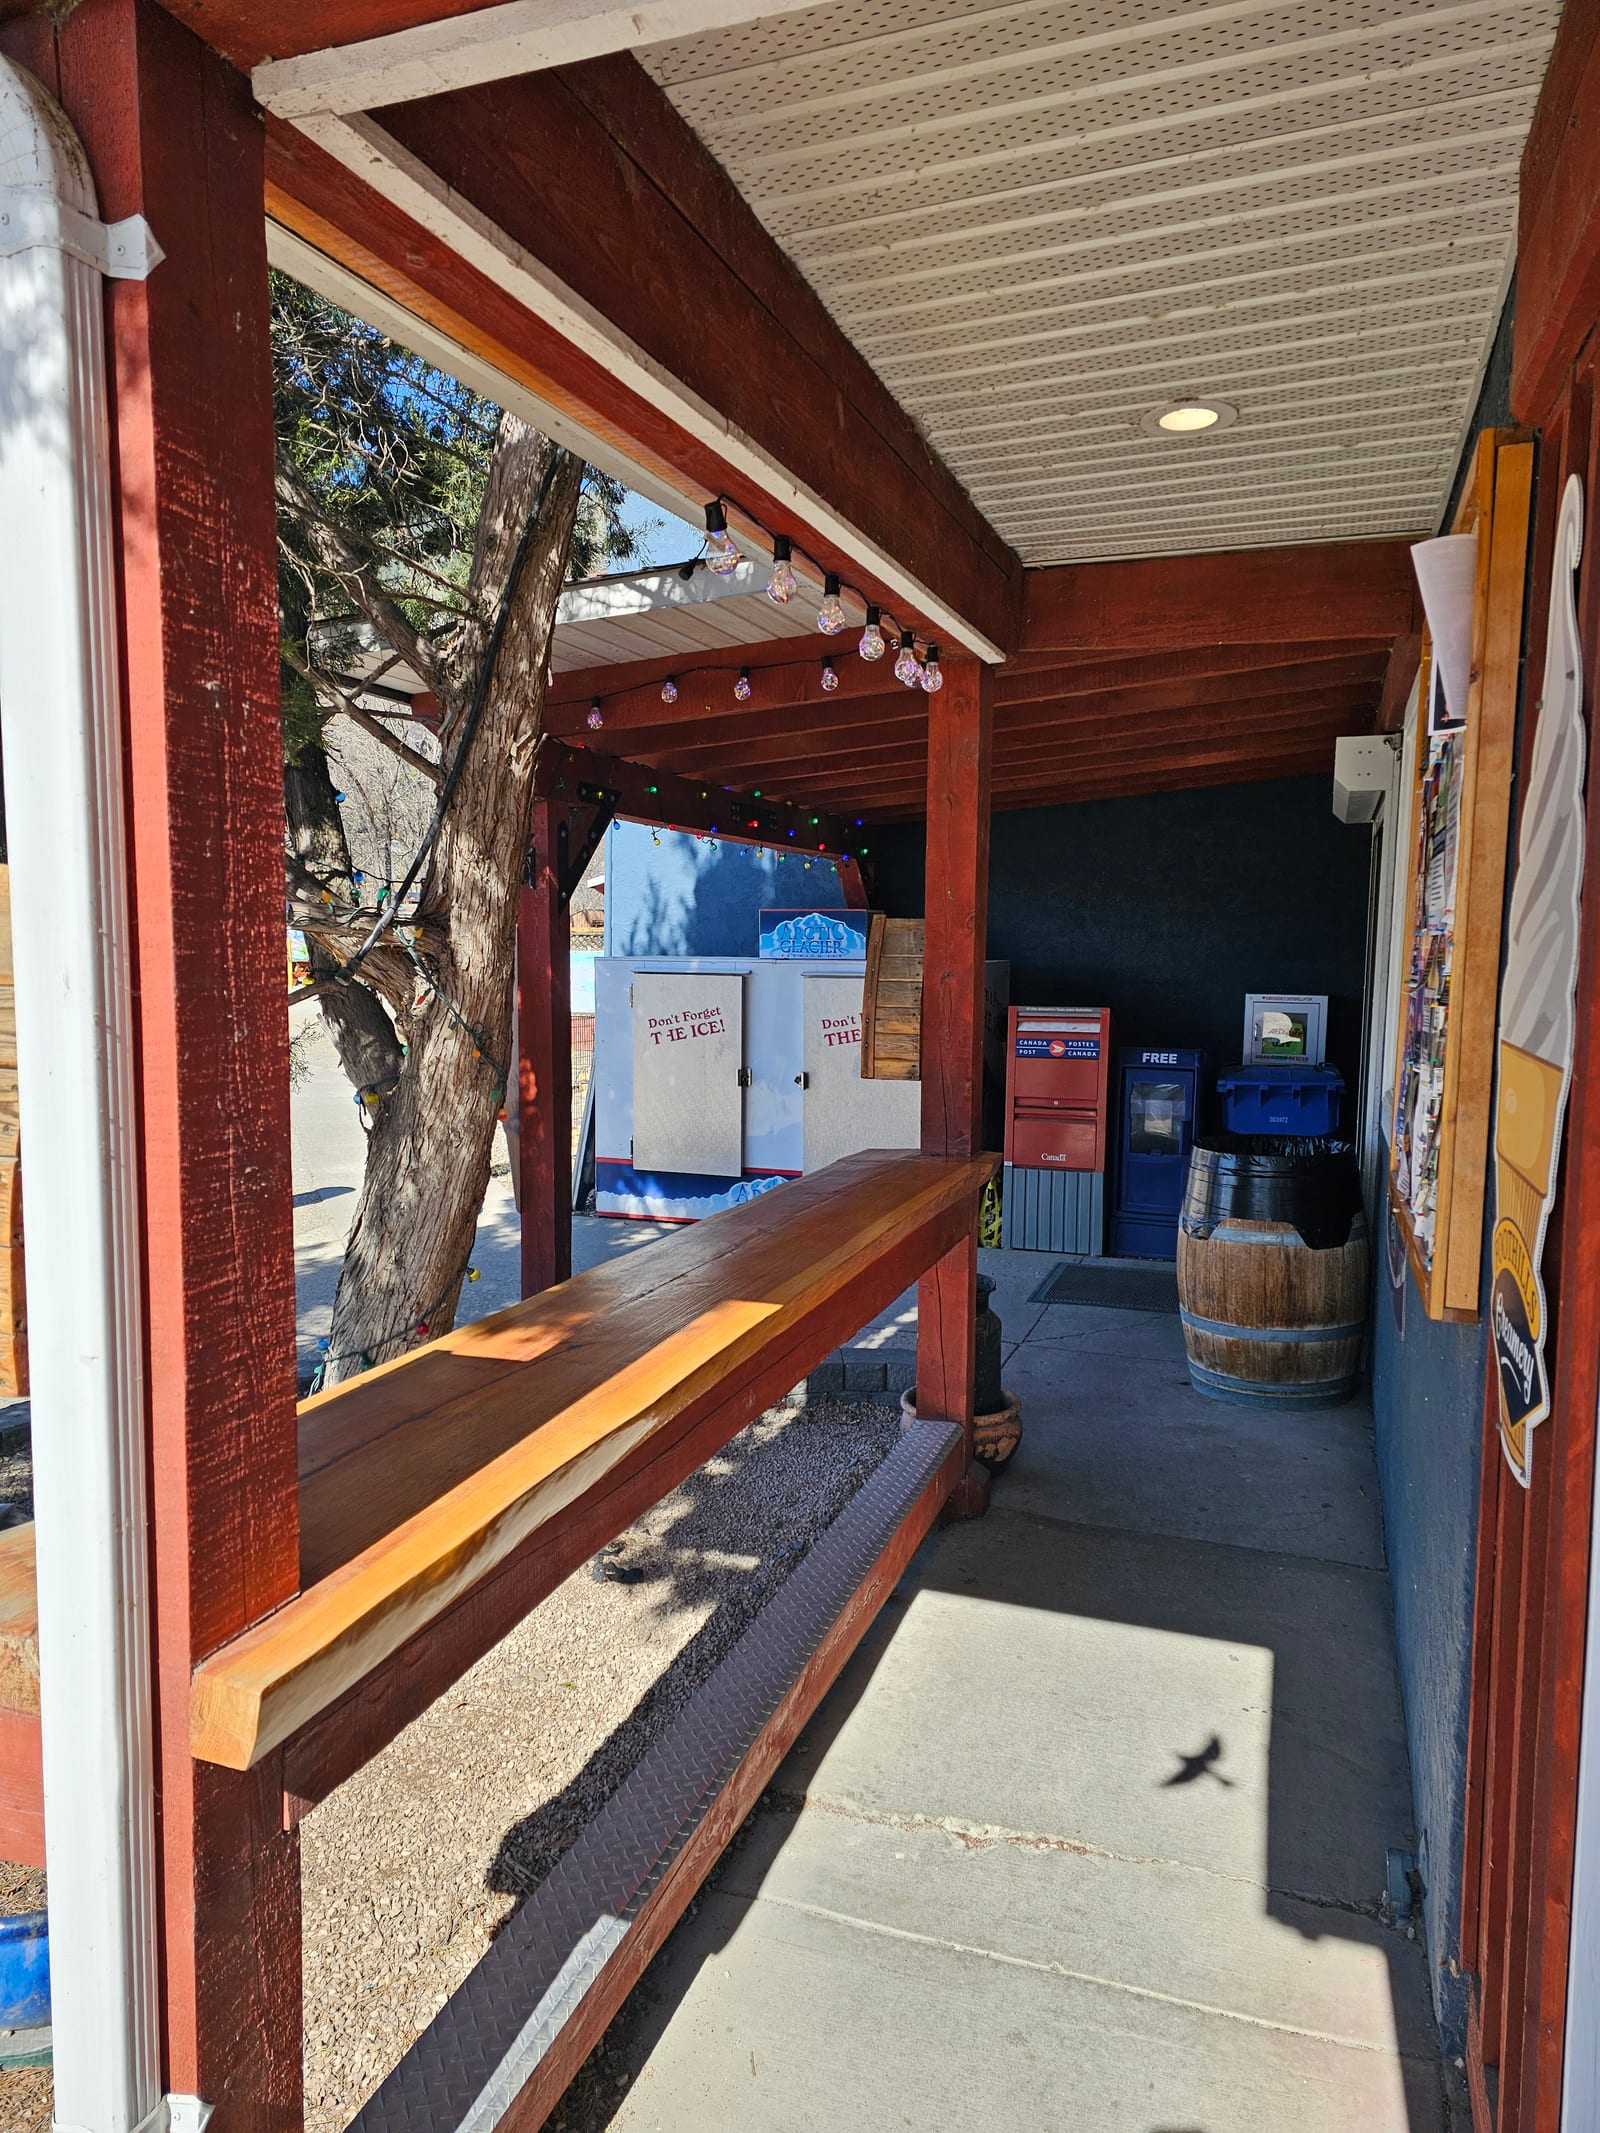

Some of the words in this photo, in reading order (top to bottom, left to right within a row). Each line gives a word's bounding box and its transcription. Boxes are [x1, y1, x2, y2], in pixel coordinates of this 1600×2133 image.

[780, 922, 845, 941] ARCTIC
[780, 940, 844, 954] GLACIER
[648, 1014, 681, 1029] Don't
[681, 1006, 722, 1022] Forget
[821, 1015, 857, 1030] Don't
[690, 1018, 726, 1039] ICE!
[823, 1028, 862, 1047] THE
[1068, 1041, 1094, 1049] POSTES
[1067, 1050, 1097, 1058] CANADA
[1142, 1052, 1178, 1064] FREE
[1041, 1153, 1067, 1162] Canada
[1496, 1293, 1535, 1405] Creamery
